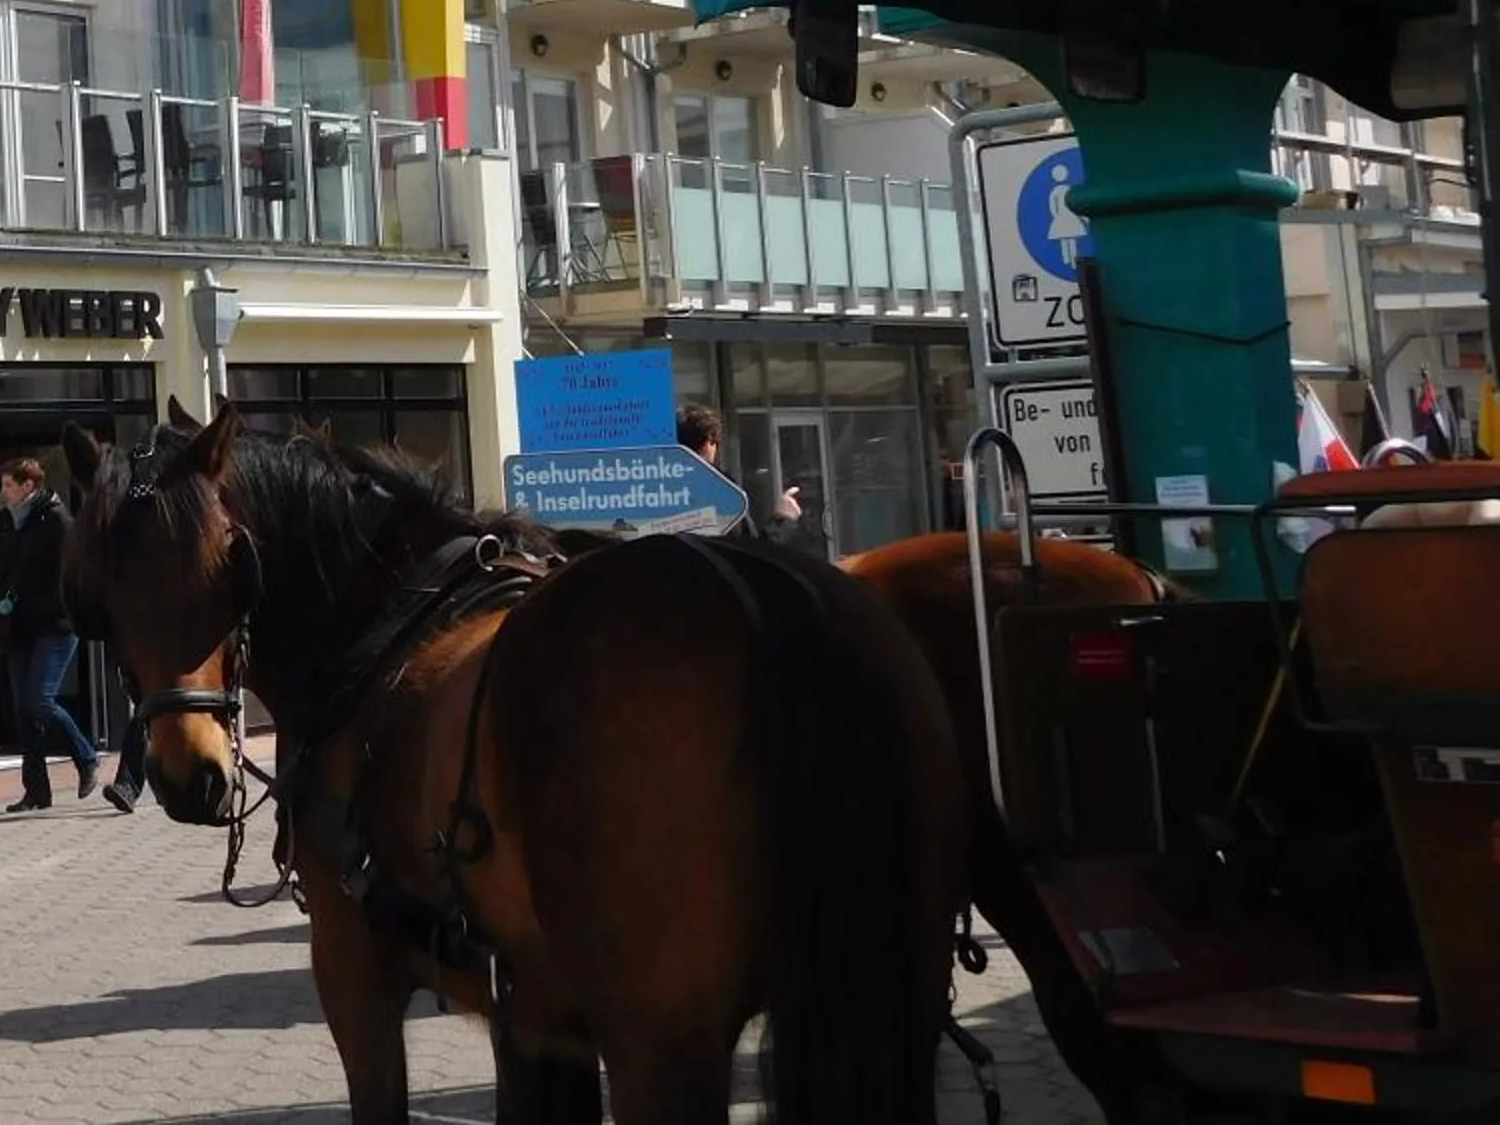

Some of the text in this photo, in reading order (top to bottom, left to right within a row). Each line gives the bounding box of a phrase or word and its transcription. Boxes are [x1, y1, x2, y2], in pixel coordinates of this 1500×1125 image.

[17, 289, 164, 339] WEBER
[1013, 399, 1051, 422] Be-
[1053, 435, 1091, 453] von
[513, 457, 695, 486] Seehundsbänke-
[515, 482, 692, 513] & Inselrundfahrt
